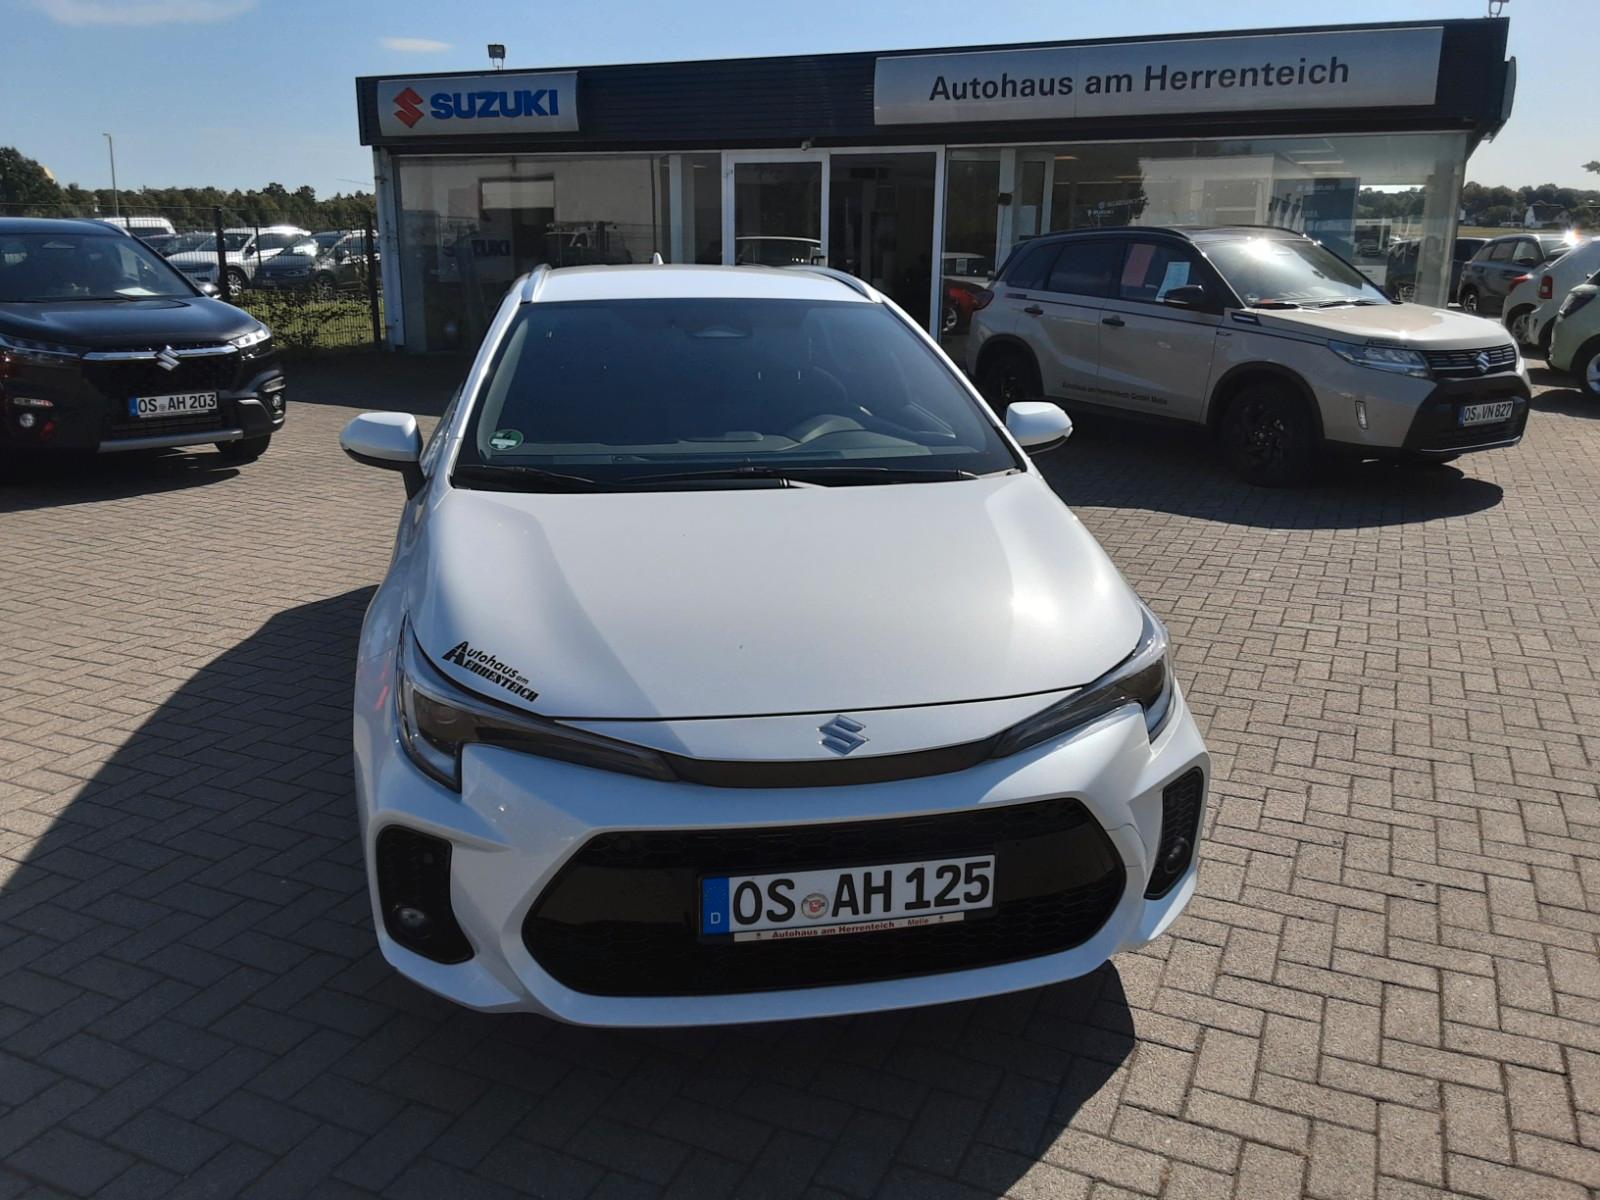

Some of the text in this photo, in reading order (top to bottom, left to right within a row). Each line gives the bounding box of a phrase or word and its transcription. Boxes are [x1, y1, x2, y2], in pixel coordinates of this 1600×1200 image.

[929, 56, 1350, 101] Autohaus am Herrenteich
[431, 89, 559, 119] SUZUKI
[138, 394, 216, 413] OS AH 203
[1465, 402, 1513, 422] OS VN 827
[732, 861, 992, 925] OS AH 125
[710, 912, 721, 925] D
[772, 928, 818, 939] Autohaus
[821, 927, 836, 936] am
[838, 921, 895, 934] Herrenteich
